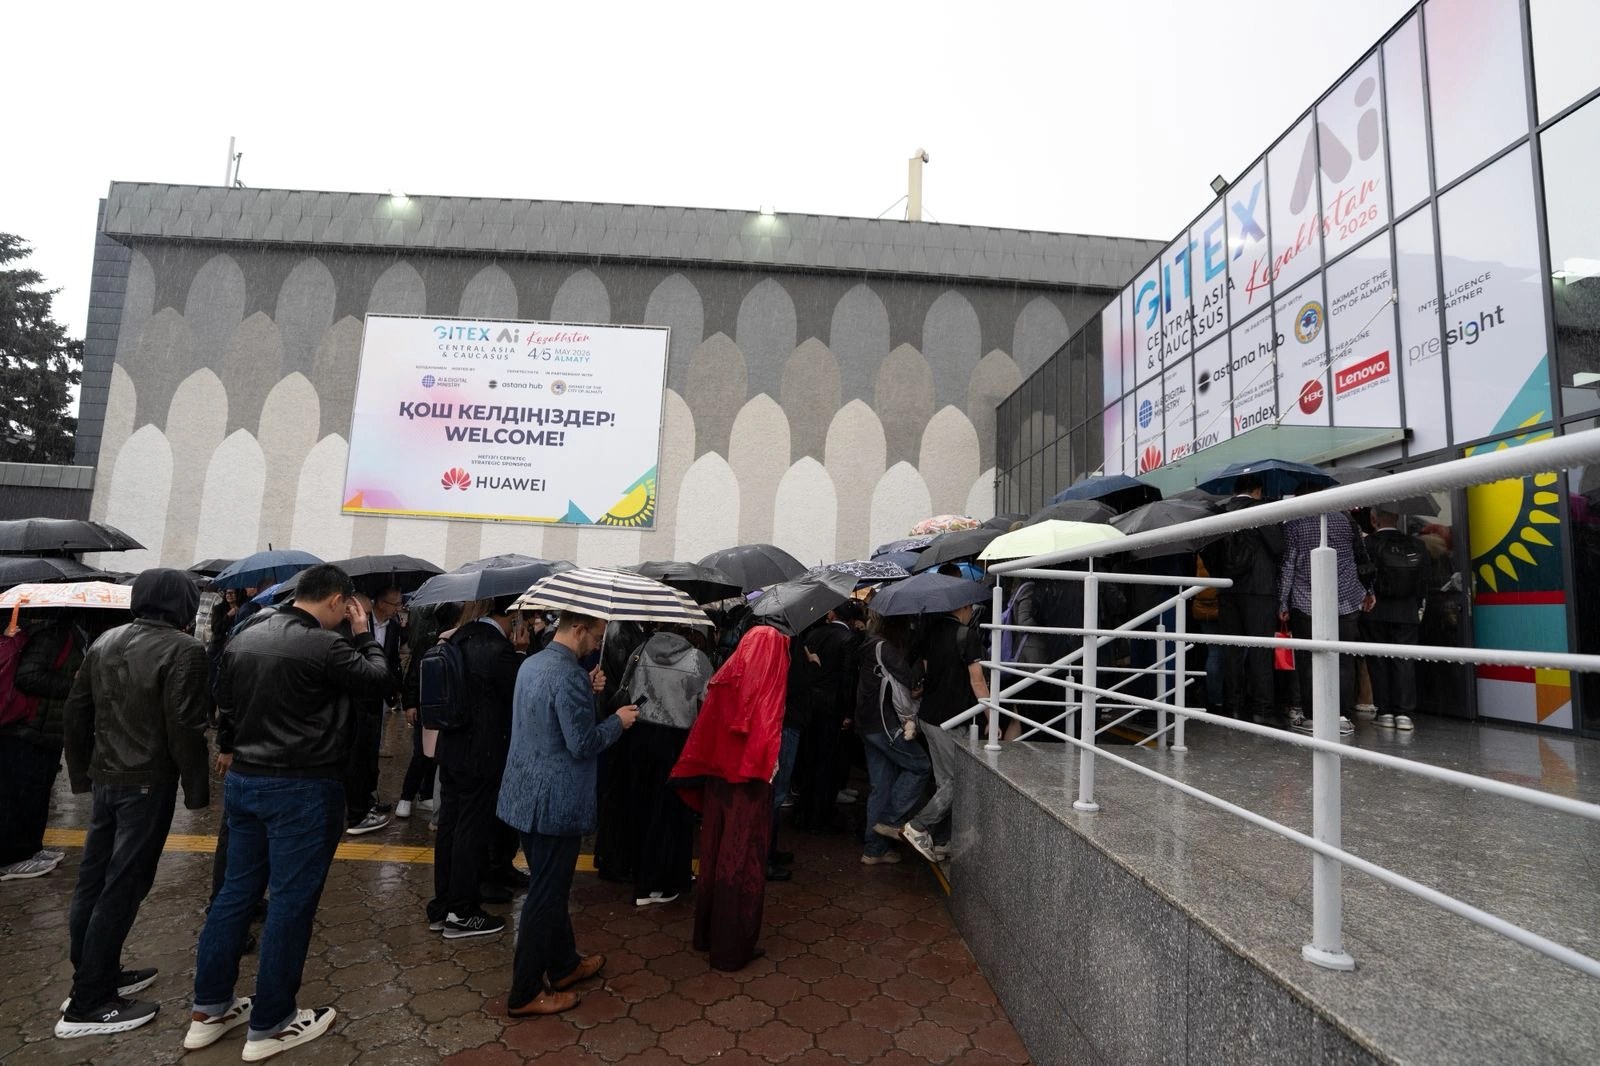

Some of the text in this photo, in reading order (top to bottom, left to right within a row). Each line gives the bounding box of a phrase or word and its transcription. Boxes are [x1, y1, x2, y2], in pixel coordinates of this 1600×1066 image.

[1339, 204, 1378, 241] 2026
[1135, 179, 1265, 330] GITEX
[1245, 177, 1381, 304] Kazakhstan
[1332, 270, 1388, 307] AKIMAT OF THE
[1332, 280, 1391, 316] CITY OF ALMATY
[1418, 272, 1491, 312] INTELLIGENCE
[1435, 287, 1483, 315] PARTNER
[1146, 277, 1236, 351] CENTRAL ASIA
[433, 326, 490, 341] GITEX
[526, 330, 590, 346] Kazakhstan
[438, 344, 485, 352] CENTRAL
[1147, 306, 1224, 369] & CAUCASUS
[1408, 305, 1505, 366] presight
[454, 352, 509, 360] CAUCASUS
[1213, 332, 1285, 382] astana hub
[529, 382, 543, 390] hub
[1339, 361, 1386, 388] Lenovo
[399, 401, 615, 428] ҚОШ КЕЛДІҢІЗДЕР!
[1234, 405, 1276, 431] Yandex
[445, 426, 565, 447] WELCOME!
[476, 476, 546, 492] HUAWEI
